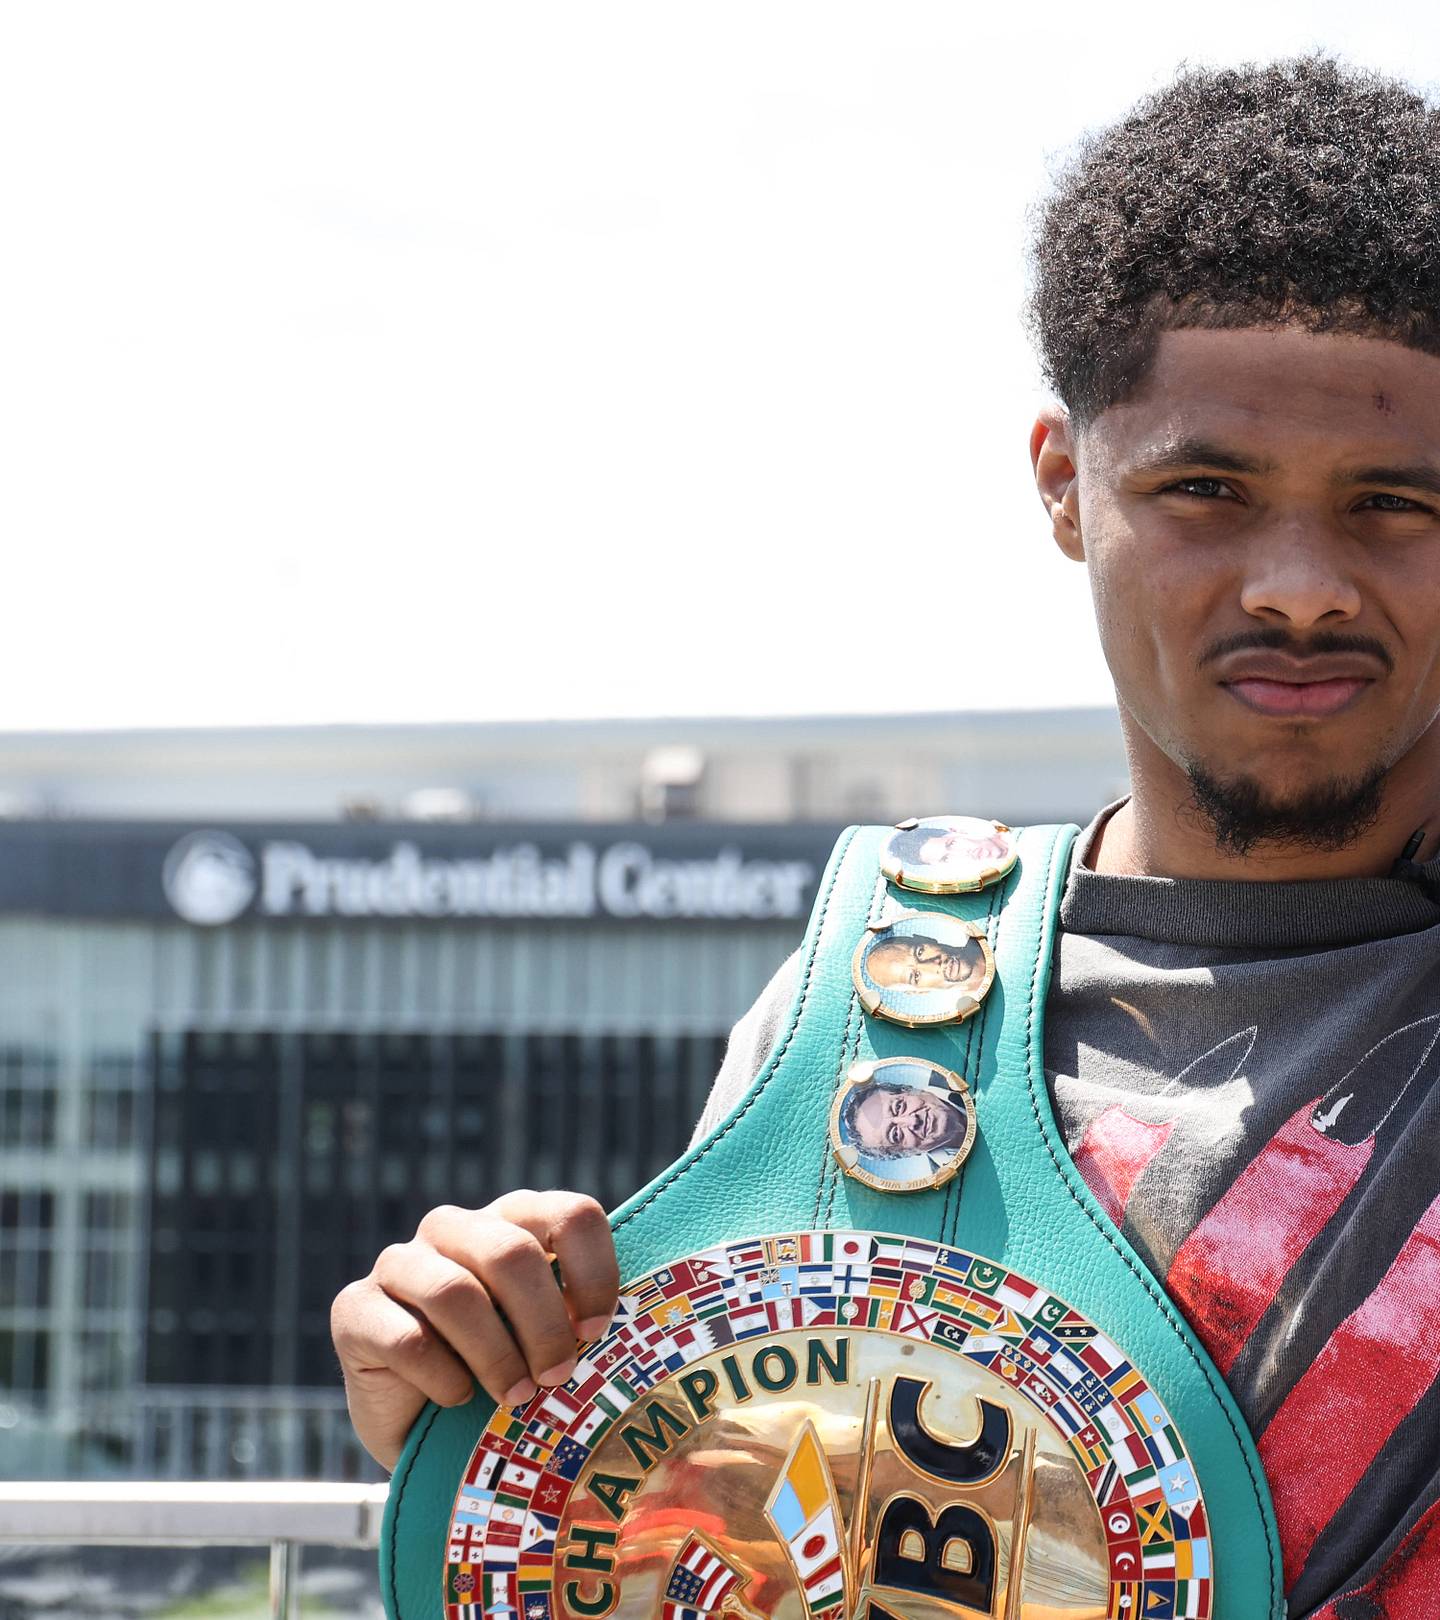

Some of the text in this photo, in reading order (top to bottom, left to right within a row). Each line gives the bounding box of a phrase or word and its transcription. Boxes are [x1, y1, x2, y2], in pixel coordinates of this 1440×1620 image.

[263, 841, 811, 917] Prudential Center
[954, 1147, 968, 1166] WBC
[966, 1123, 976, 1144] WBC
[563, 1336, 850, 1618] CHAMPION
[867, 1374, 1014, 1620] BC
